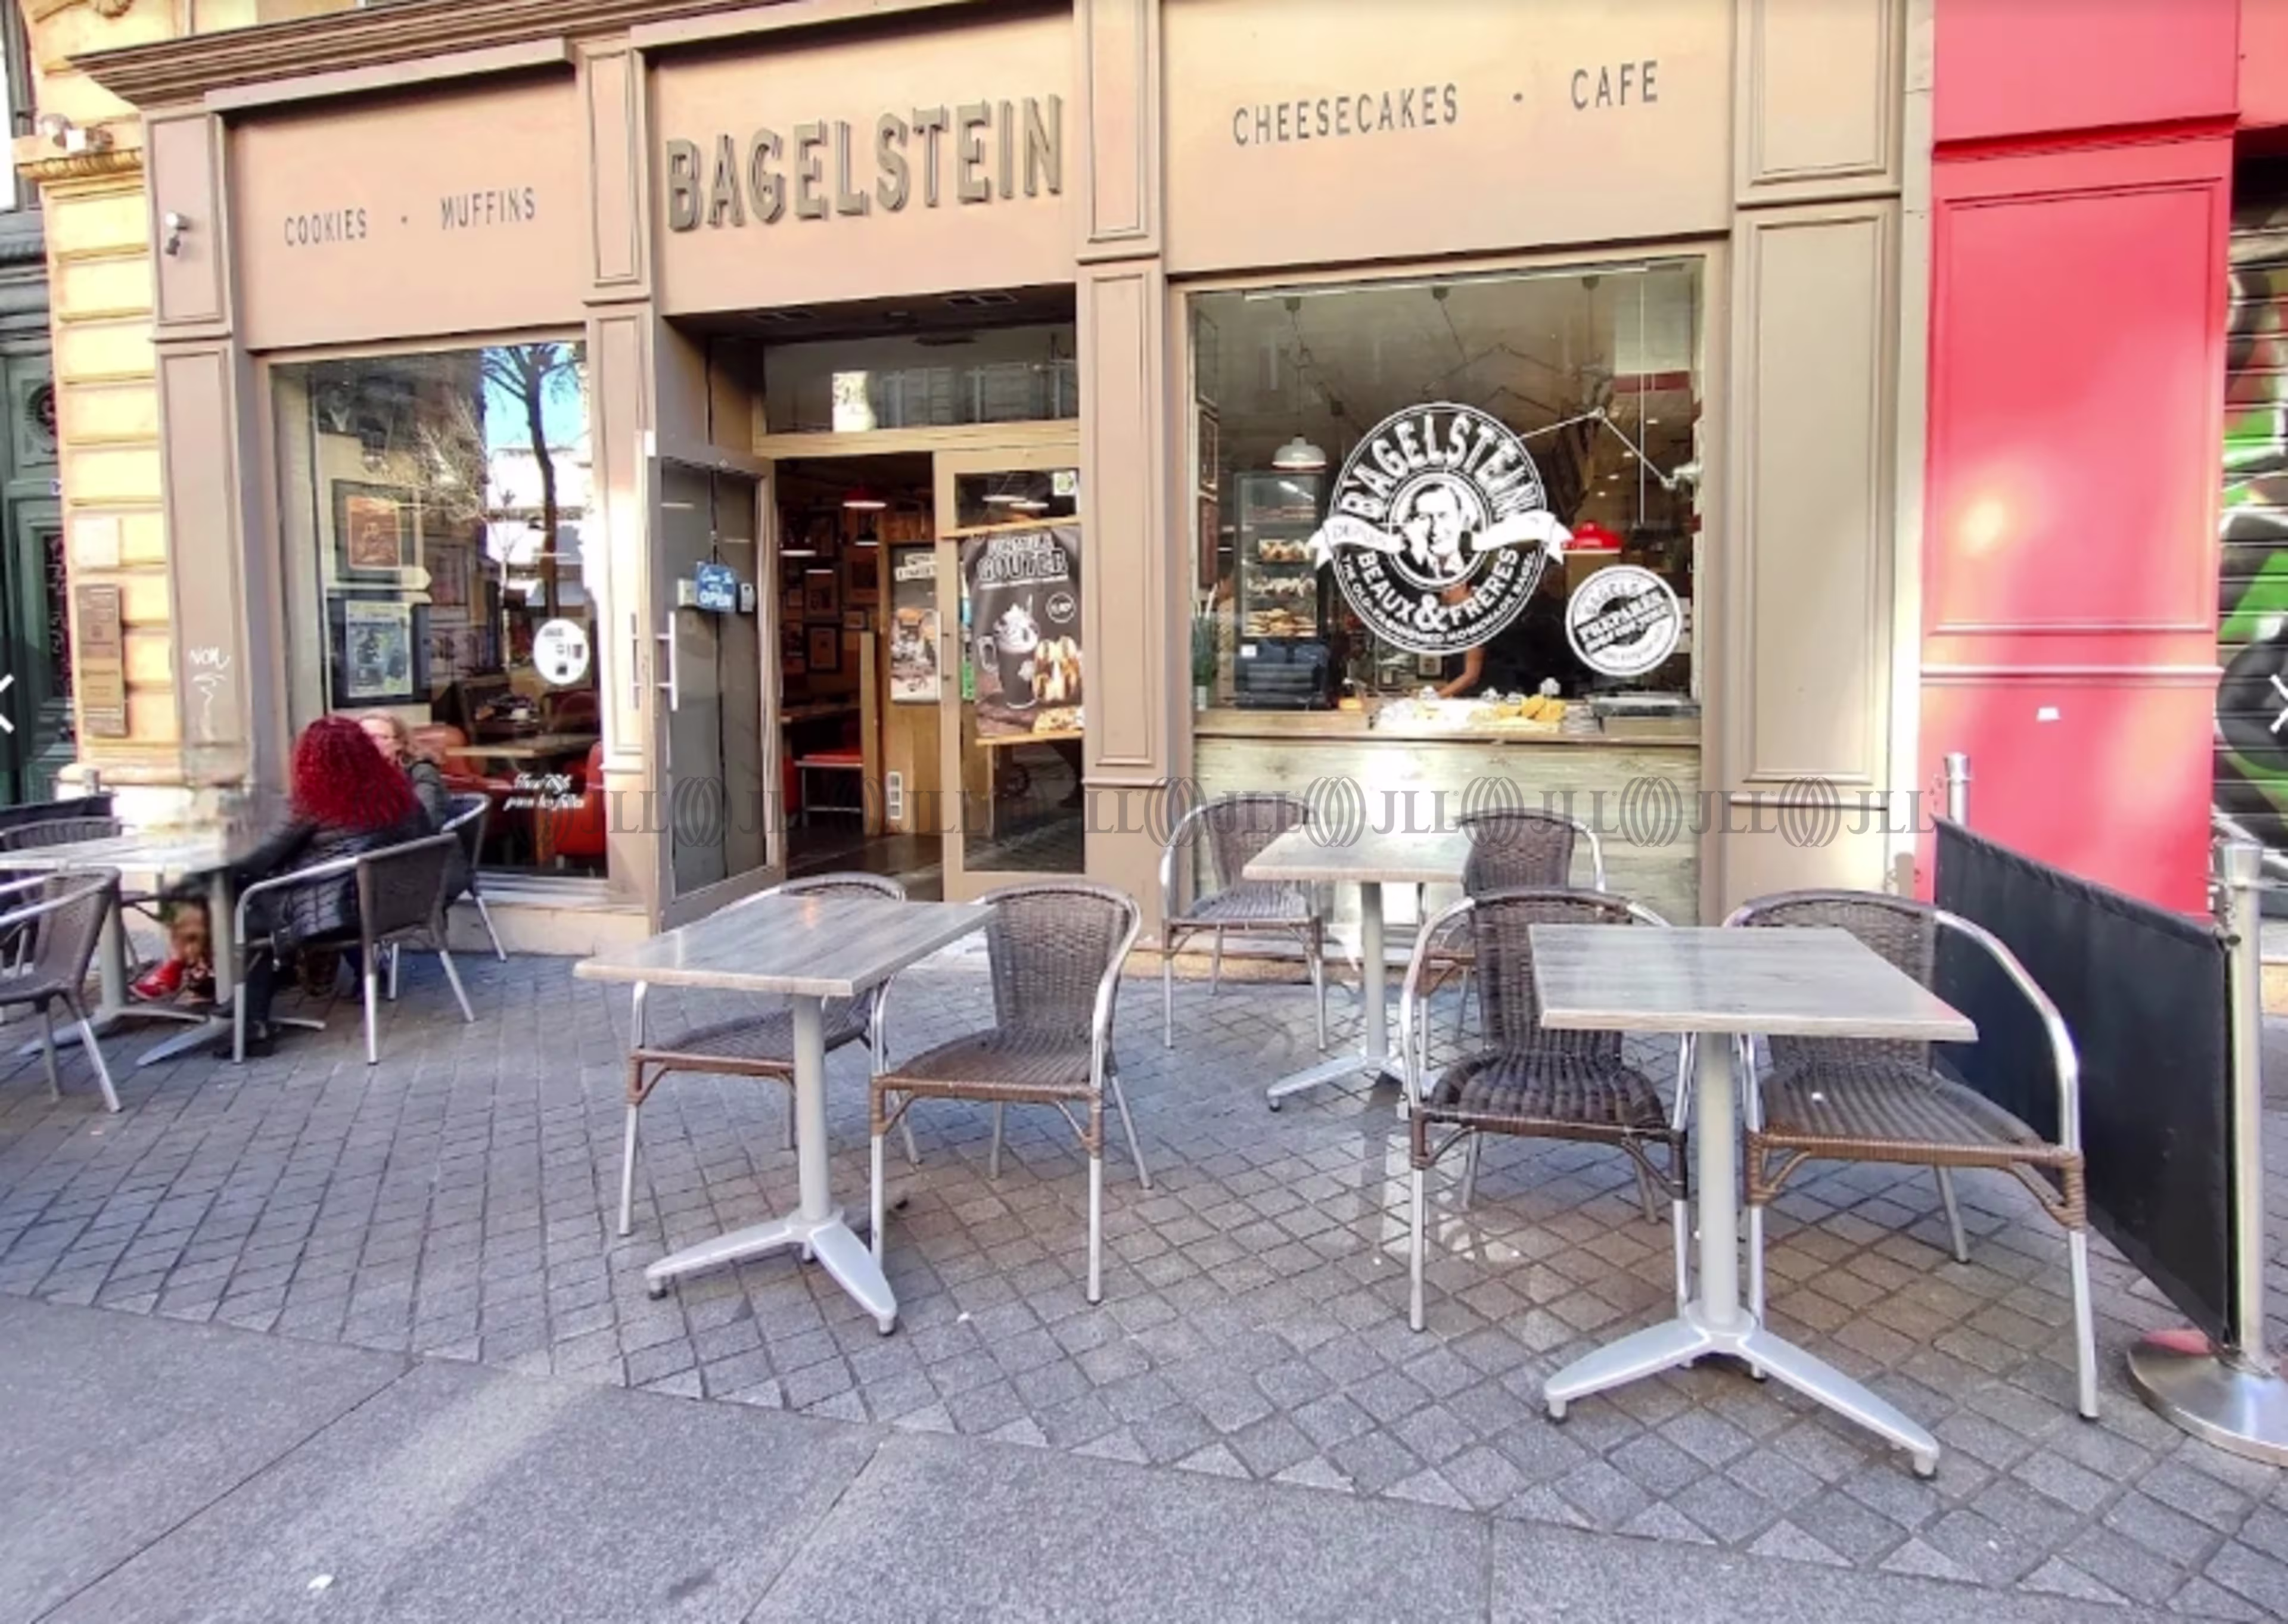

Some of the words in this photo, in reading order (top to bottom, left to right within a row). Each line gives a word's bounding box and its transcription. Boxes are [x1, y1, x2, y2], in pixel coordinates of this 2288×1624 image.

[1233, 83, 1458, 147] CHEESECAKES
[1571, 60, 1659, 110] CAFE
[666, 93, 1062, 233] BAGELSTEIN
[284, 209, 366, 246] COOKIES
[440, 186, 536, 230] MUFFINS
[1341, 411, 1542, 522] BAGELSTEIN
[1357, 550, 1416, 624] BEAUX
[1413, 593, 1450, 632] &
